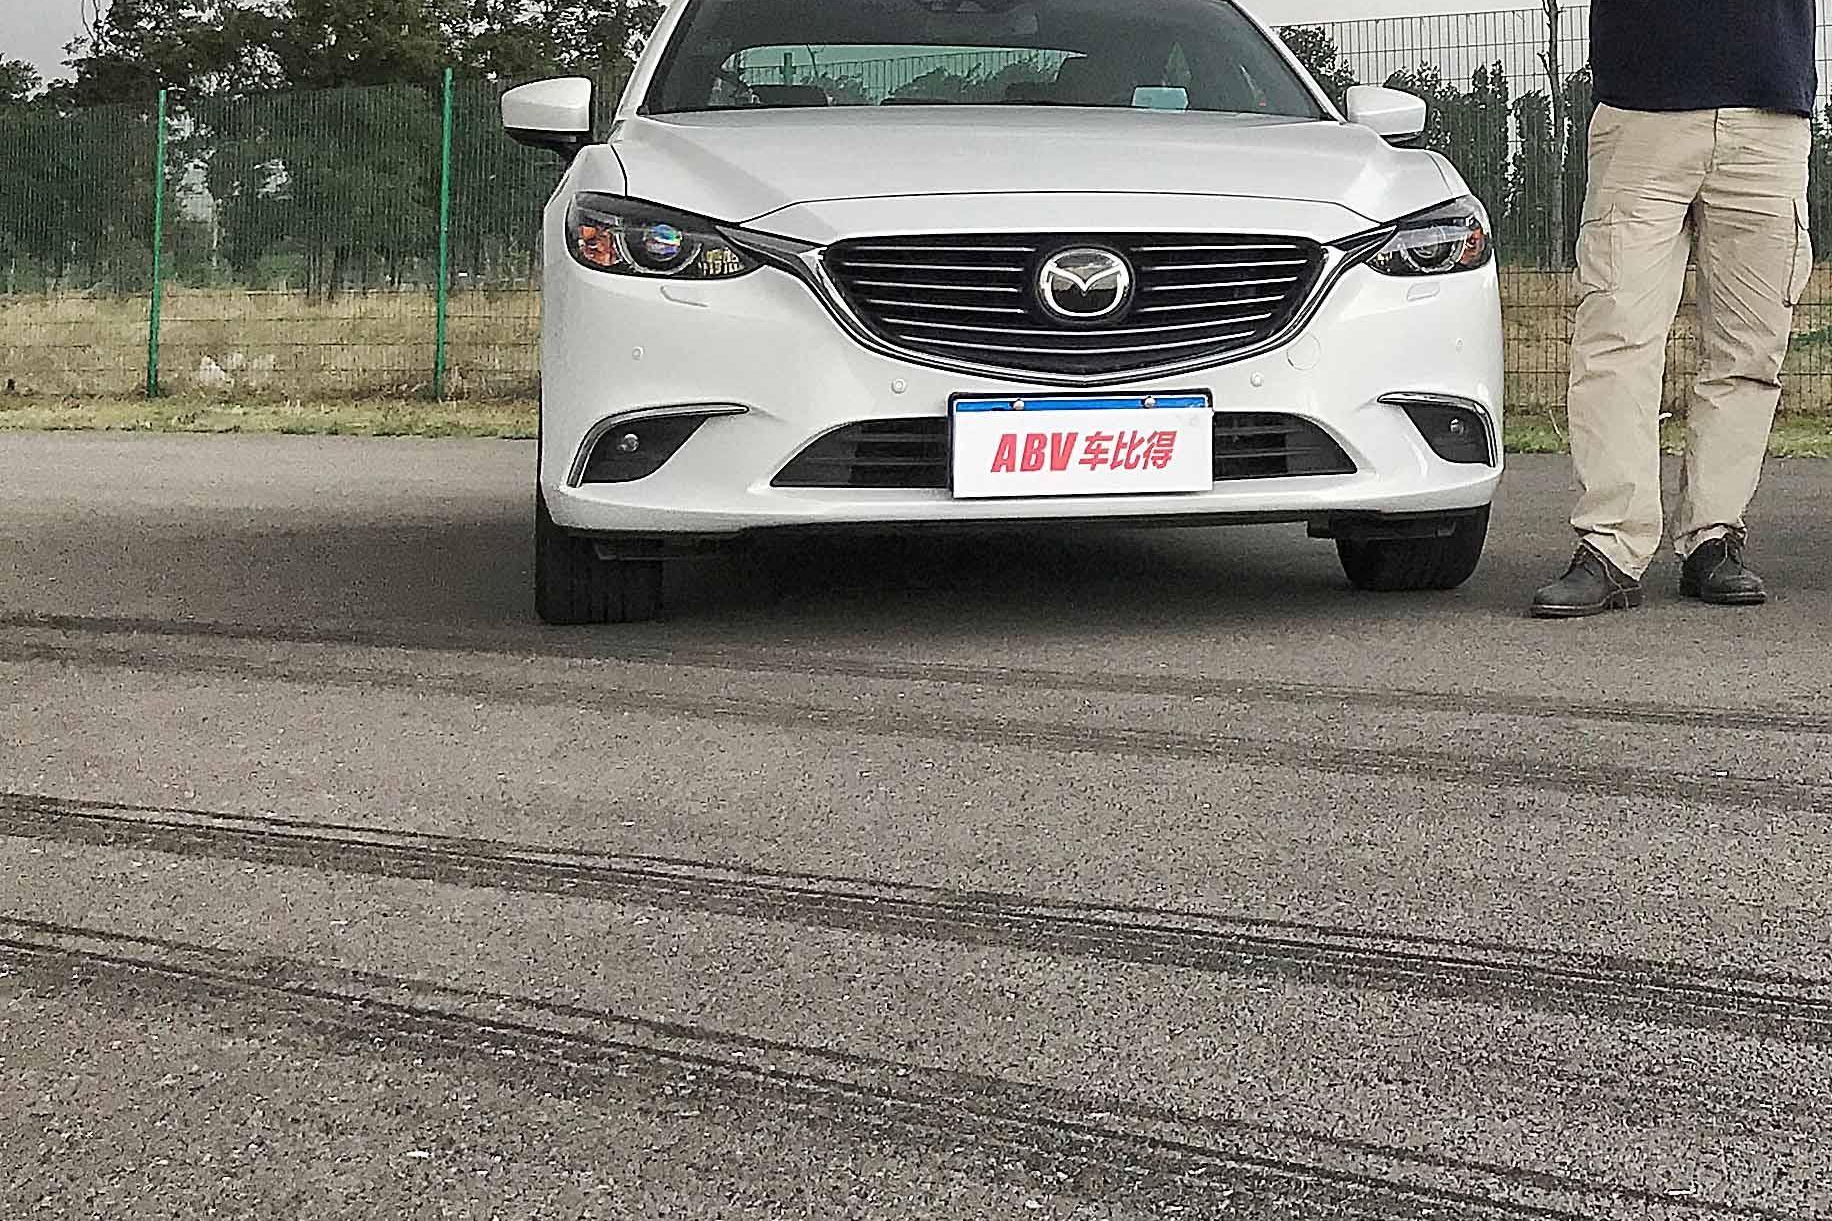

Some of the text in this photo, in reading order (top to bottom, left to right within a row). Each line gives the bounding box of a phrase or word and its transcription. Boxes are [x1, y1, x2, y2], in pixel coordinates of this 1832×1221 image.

[990, 430, 1177, 472] ABV 车比得
